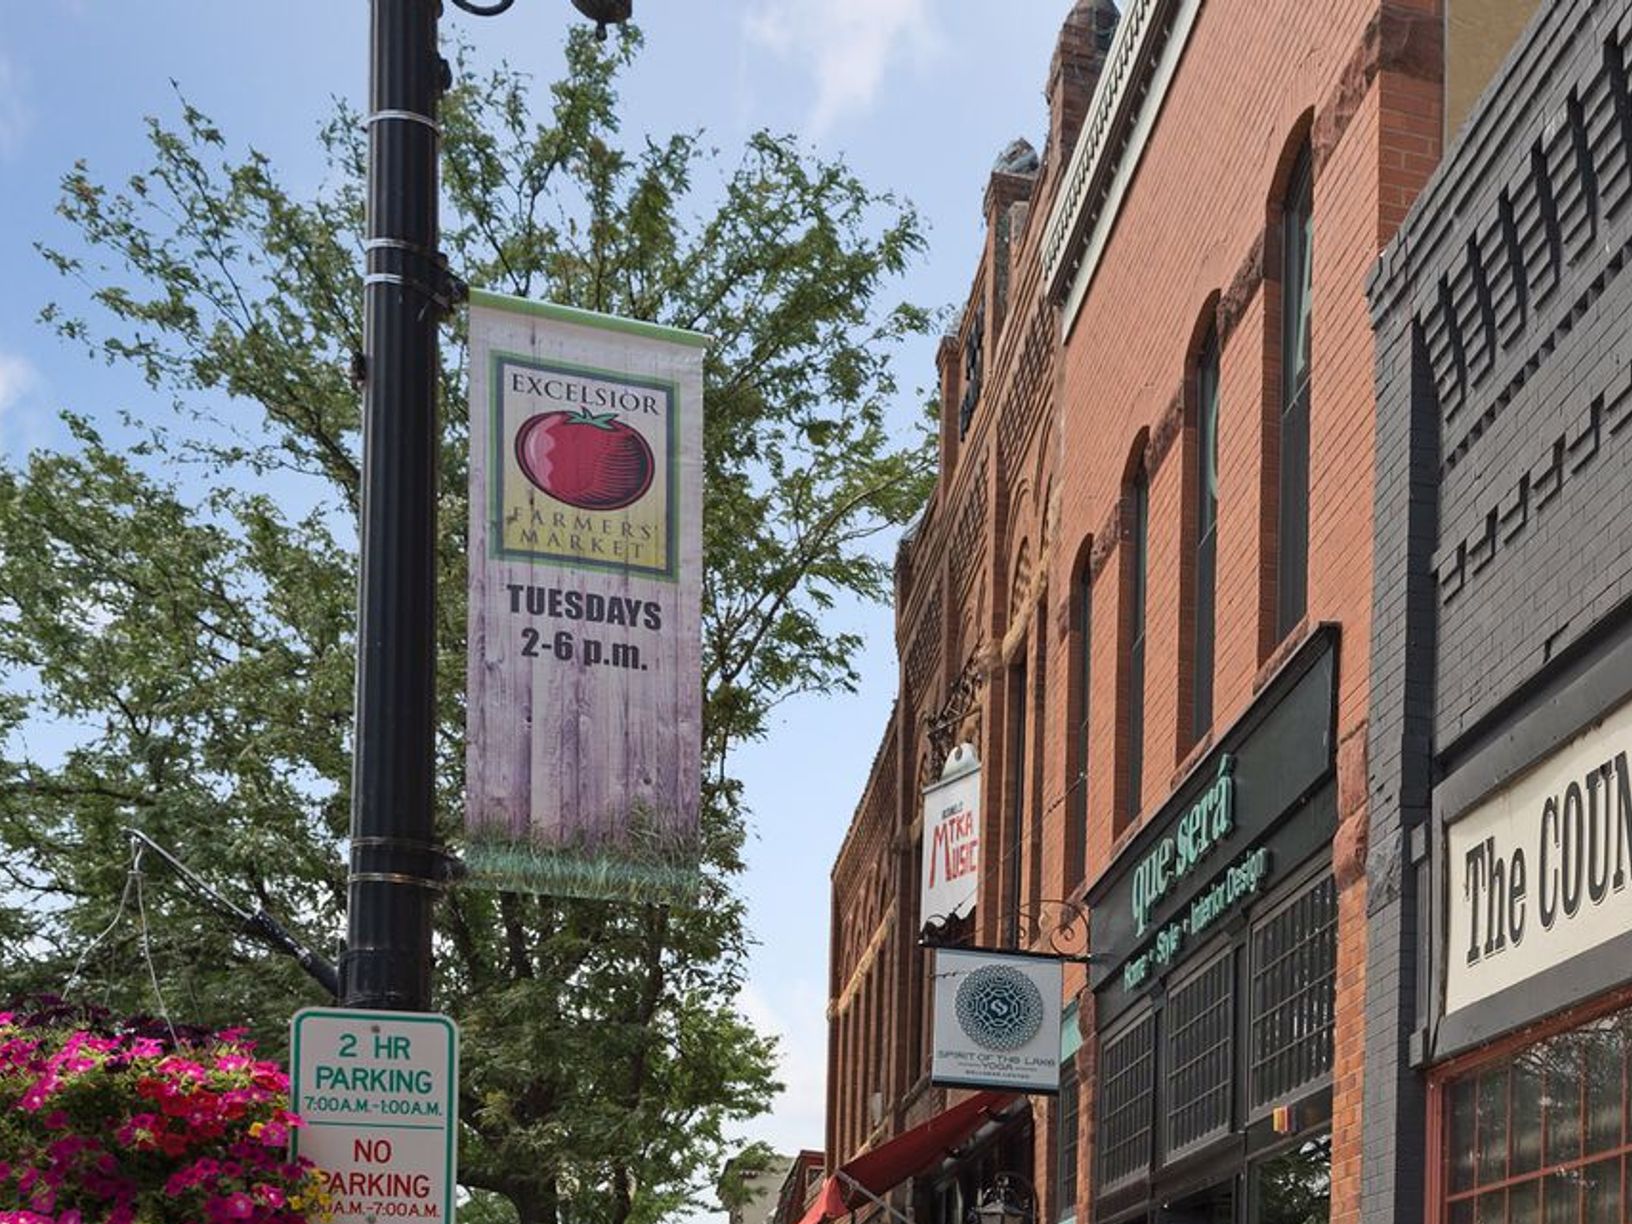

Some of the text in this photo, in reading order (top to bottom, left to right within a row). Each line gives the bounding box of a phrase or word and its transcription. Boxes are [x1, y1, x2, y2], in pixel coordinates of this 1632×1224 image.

[512, 373, 661, 416] EXCELSIOR
[519, 528, 644, 559] MARKET
[506, 584, 662, 631] TUESDAYS
[521, 627, 648, 671] 2-6 p.m.
[1132, 837, 1176, 938] que
[1227, 848, 1267, 902] Design
[1464, 836, 1526, 967] The
[339, 1033, 411, 1060] 2 HR
[982, 1061, 1013, 1070] YOGA
[315, 1066, 433, 1094] PARKING
[353, 1138, 392, 1164] NO
